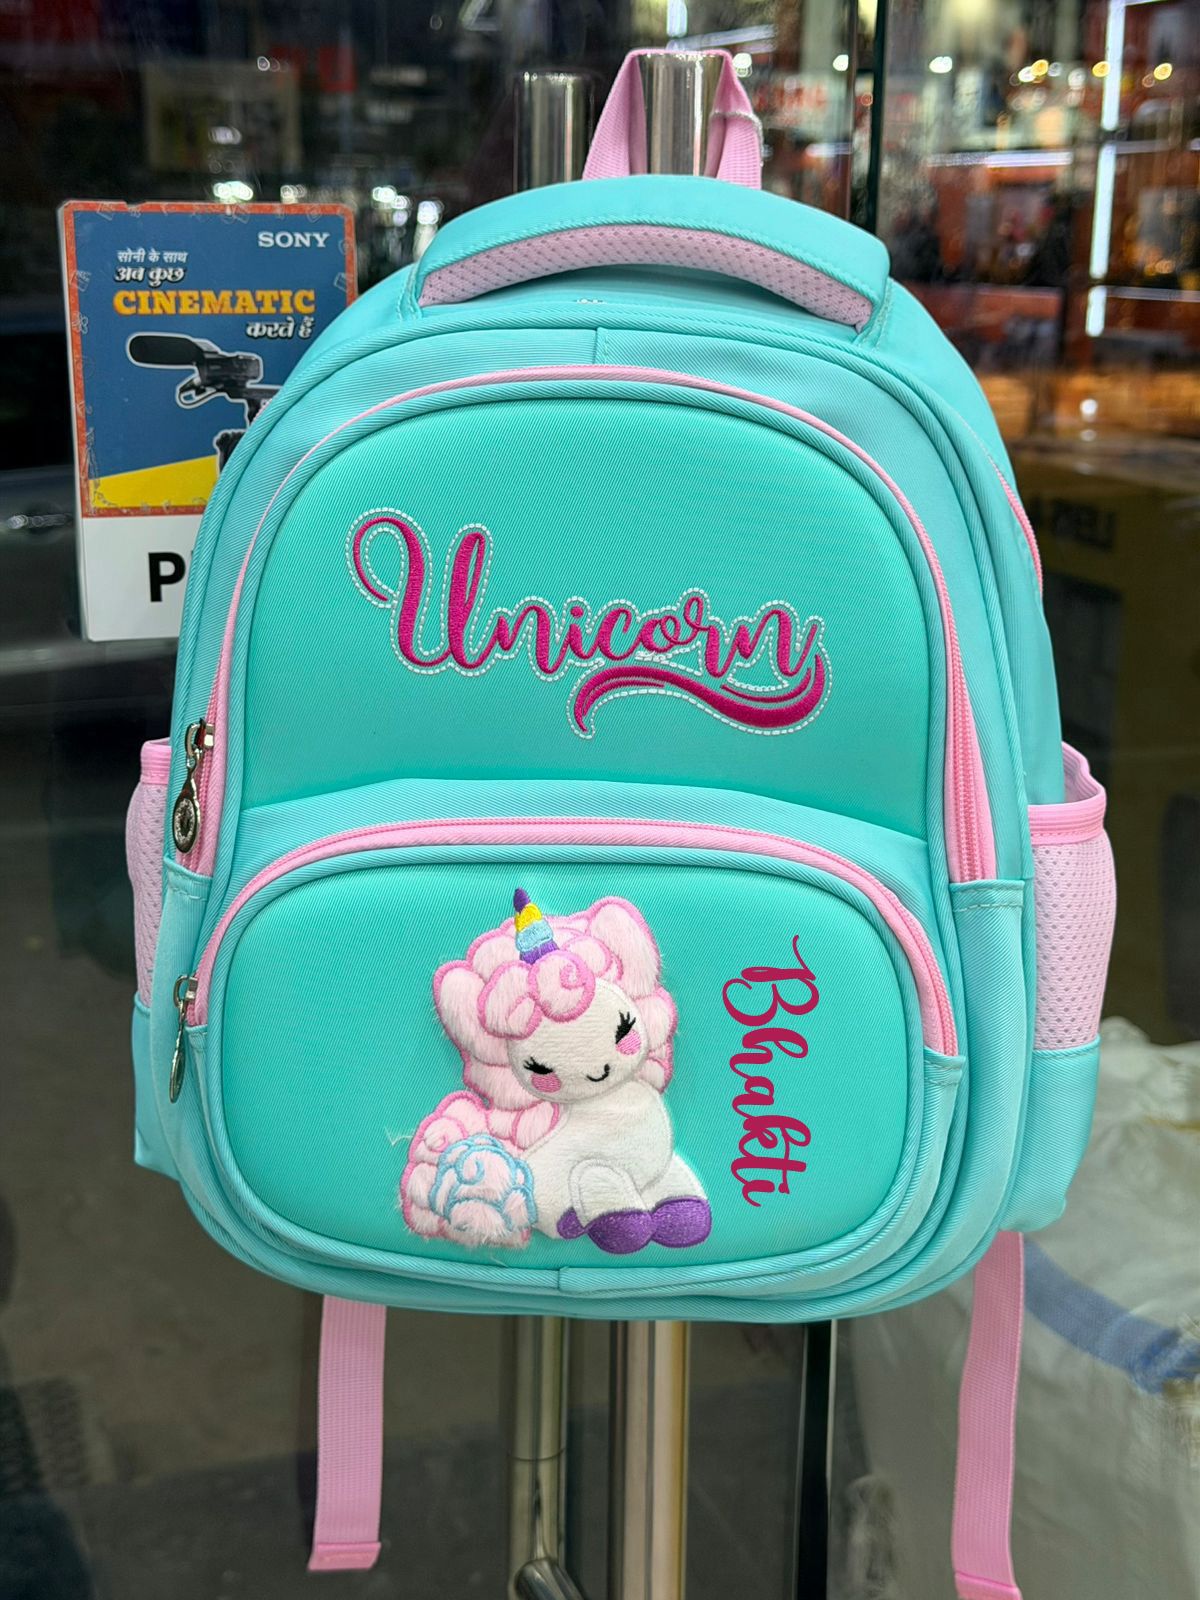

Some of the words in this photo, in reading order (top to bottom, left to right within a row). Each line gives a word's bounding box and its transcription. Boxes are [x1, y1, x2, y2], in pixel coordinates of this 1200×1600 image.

[257, 231, 330, 248] SONY
[117, 247, 146, 263] सोनी
[147, 247, 161, 263] के
[162, 250, 188, 263] साथ
[147, 266, 186, 287] कुछ
[113, 289, 315, 316] CINEMATIC
[246, 315, 296, 338] करते
[349, 511, 829, 736] Unicorn
[721, 933, 820, 1208] Bhakti
